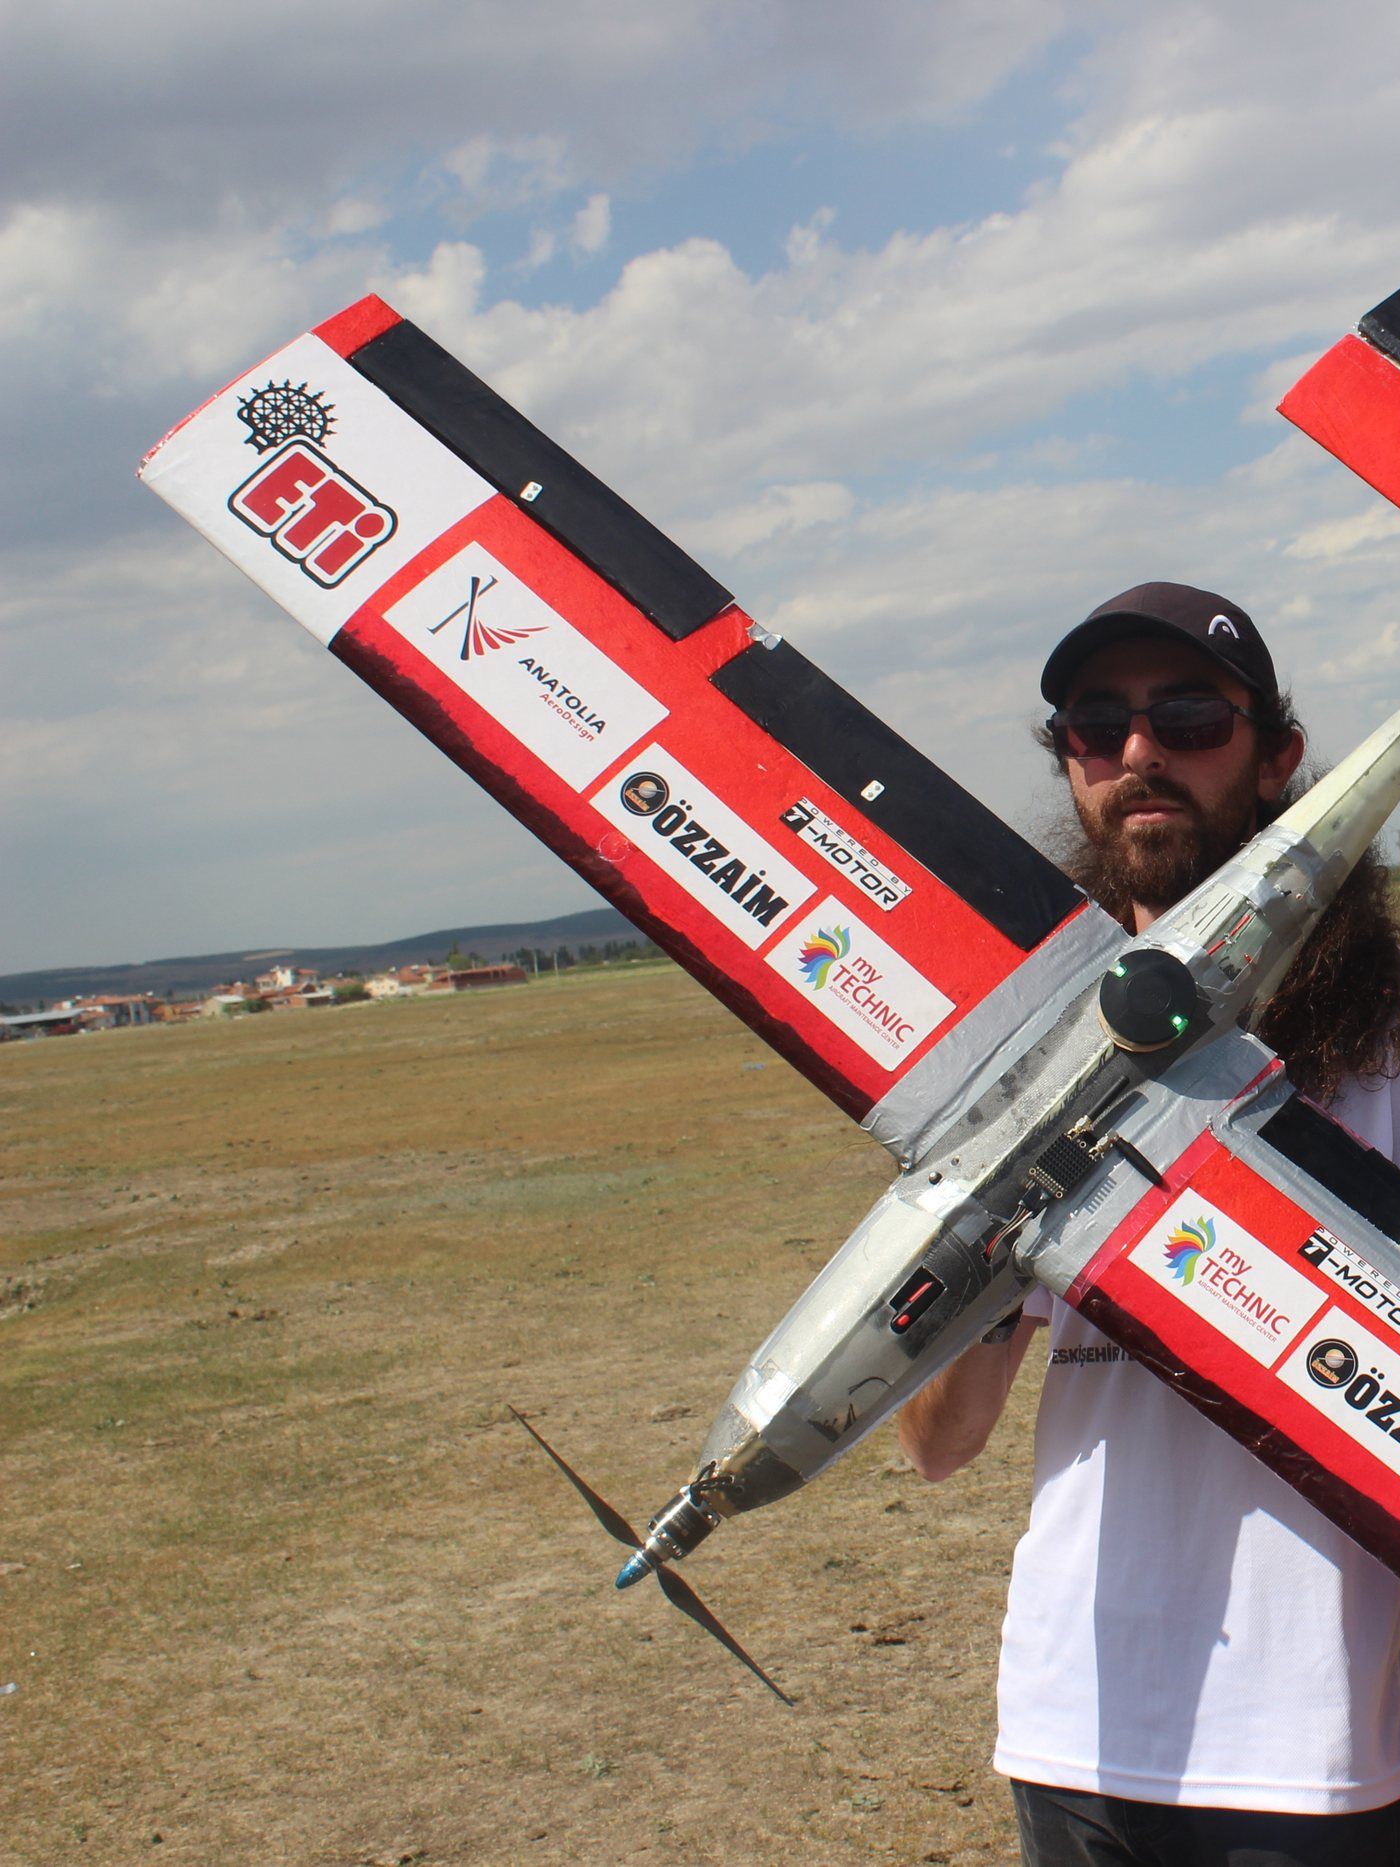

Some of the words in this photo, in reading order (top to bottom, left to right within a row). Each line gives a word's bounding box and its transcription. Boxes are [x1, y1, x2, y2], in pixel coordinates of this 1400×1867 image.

[518, 657, 606, 734] ANATOLIA
[539, 693, 595, 742] AeroDesign
[652, 798, 790, 927] ÖZZAİM
[785, 805, 899, 905] T-MOTOR
[800, 797, 879, 867] POWERED
[890, 876, 911, 893] BY
[832, 964, 915, 1043] TECHNIC
[851, 956, 883, 984] my
[828, 984, 852, 1007] AIRCRAFT
[850, 1003, 883, 1036] MAINTENANCE
[880, 1031, 901, 1051] CENTER
[1200, 1257, 1291, 1336] TECHNIC
[1219, 1247, 1253, 1277] my
[1198, 1279, 1223, 1301] AIRCRAFT
[1221, 1297, 1257, 1329] MAINTENANCE
[1255, 1324, 1278, 1343] CENTER
